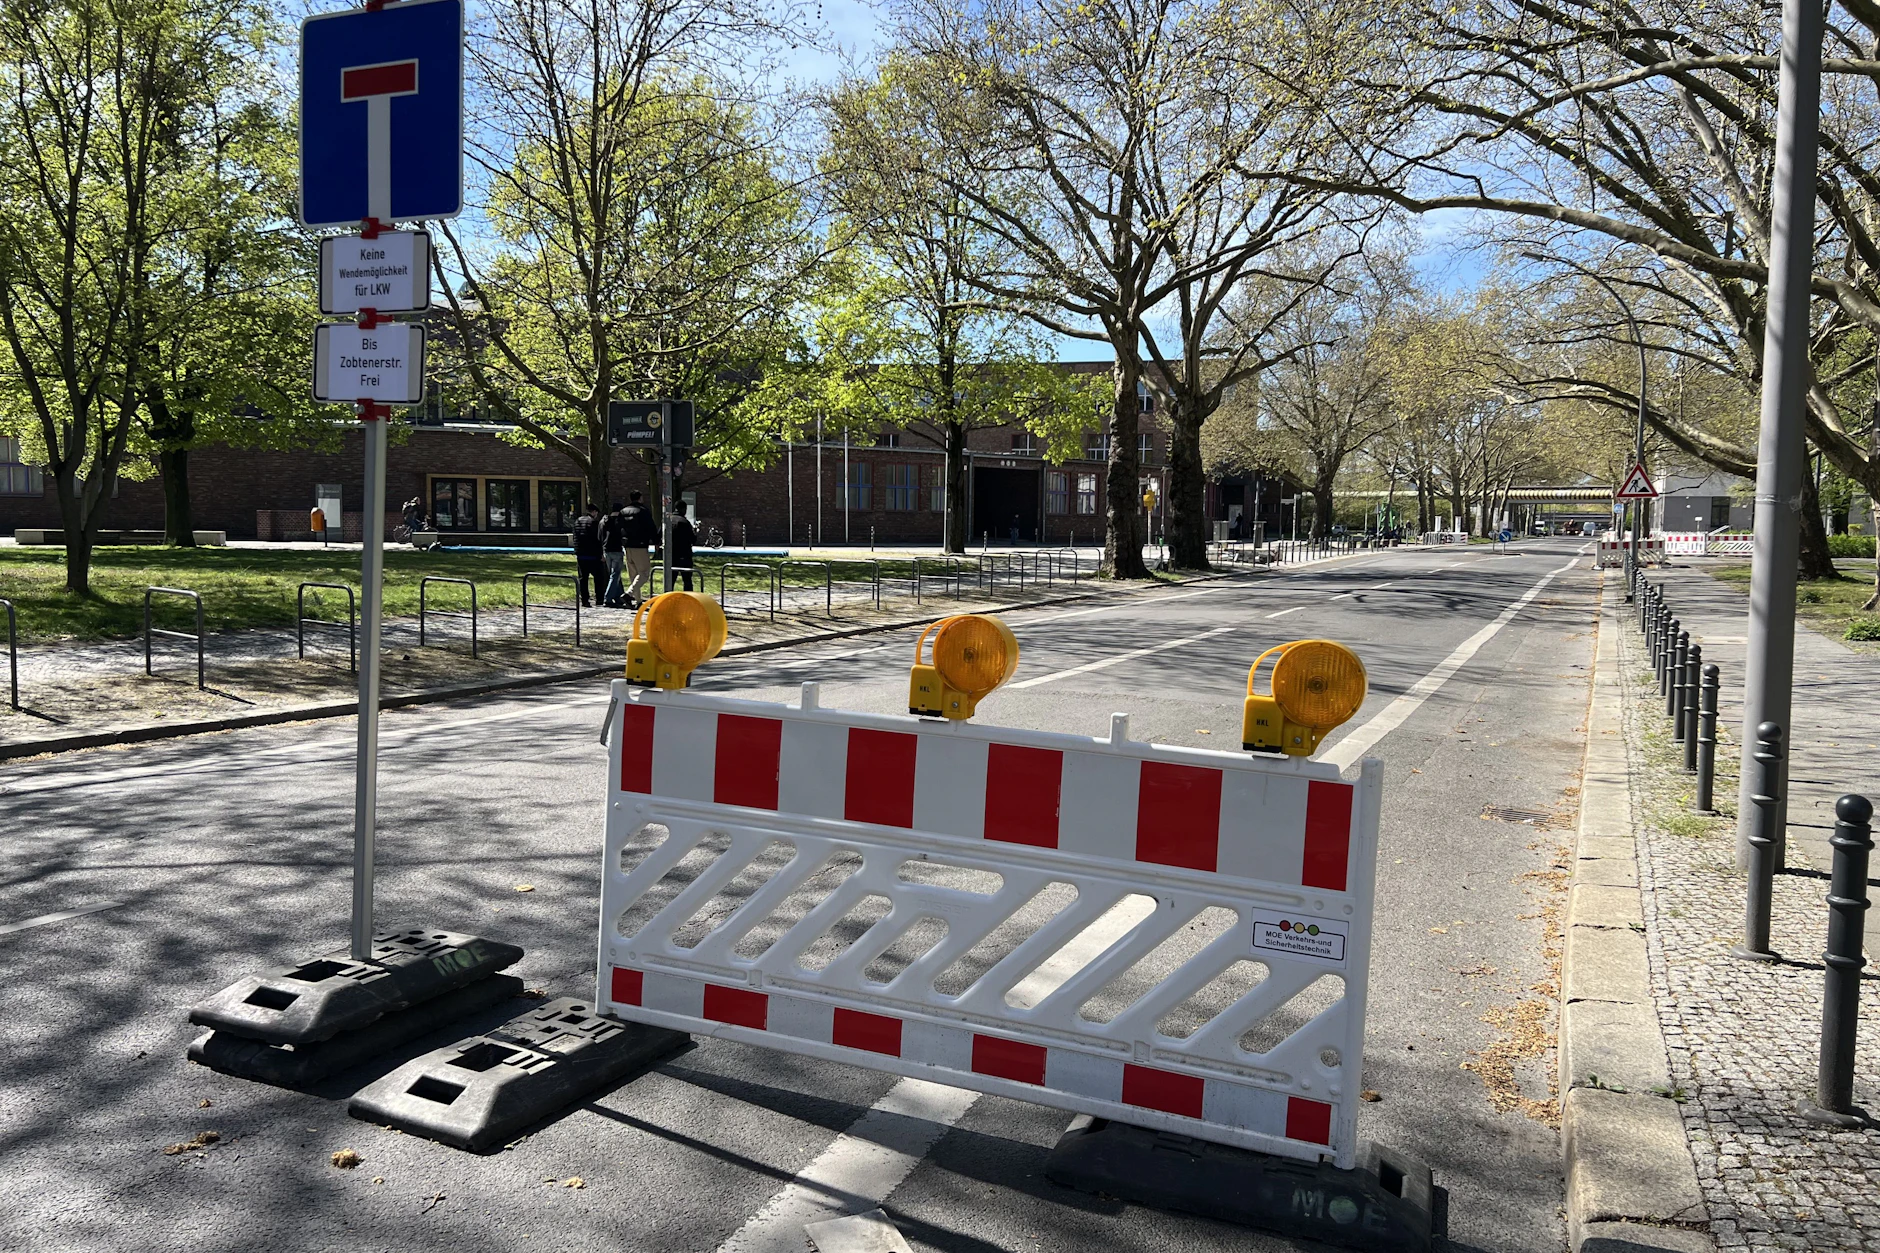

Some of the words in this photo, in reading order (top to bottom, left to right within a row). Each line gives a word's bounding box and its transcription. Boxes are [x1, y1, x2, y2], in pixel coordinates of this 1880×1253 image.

[360, 248, 386, 261] Keine
[339, 265, 408, 279] Wendemöglichkeit
[355, 284, 367, 297] für
[370, 283, 391, 296] LKW
[361, 337, 378, 350] Bis
[340, 356, 402, 369] Zobtenerstr.
[360, 374, 380, 386] Frei
[1256, 718, 1269, 727] HKL
[1265, 930, 1283, 939] MOE
[1284, 933, 1332, 947] Verkehrs-und
[1265, 938, 1332, 955] Sicherheitstechnik
